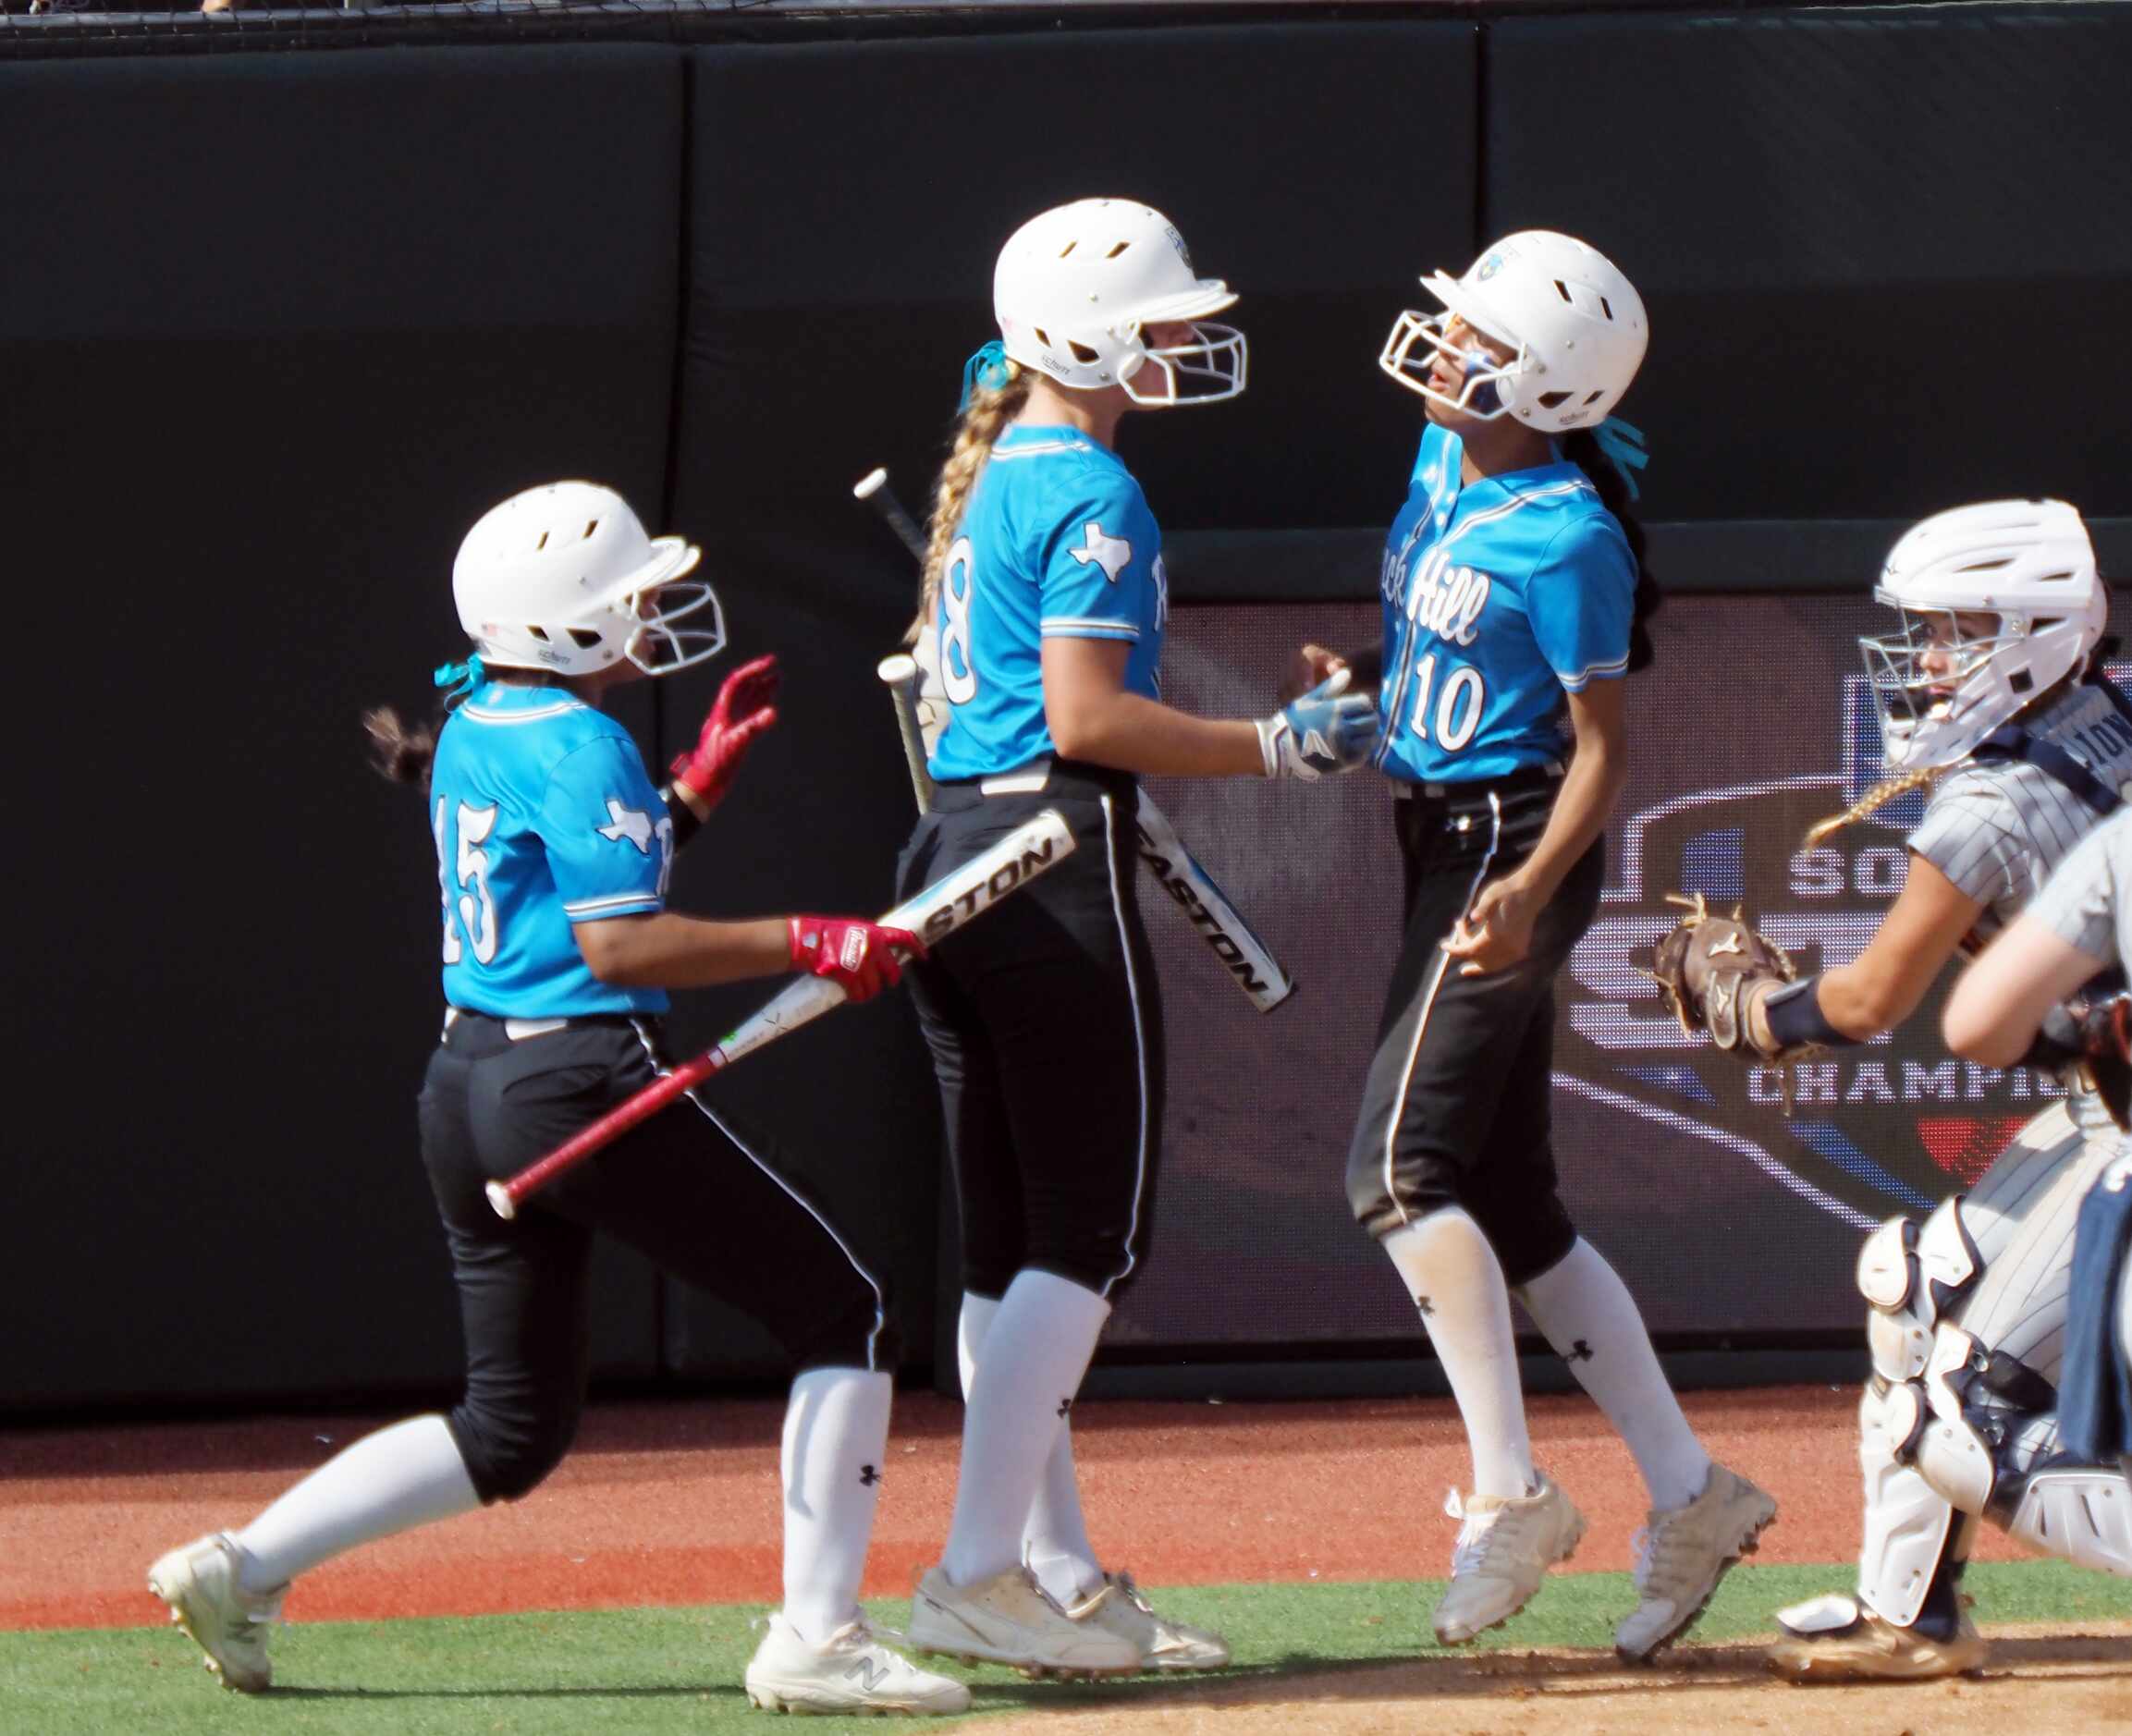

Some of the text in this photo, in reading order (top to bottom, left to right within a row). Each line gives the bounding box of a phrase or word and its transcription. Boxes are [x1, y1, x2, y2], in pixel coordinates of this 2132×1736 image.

[940, 535, 976, 704] 8
[1406, 544, 1491, 647] Hill
[1411, 653, 1486, 753] 10
[435, 795, 499, 963] 15
[924, 837, 1053, 948] STON
